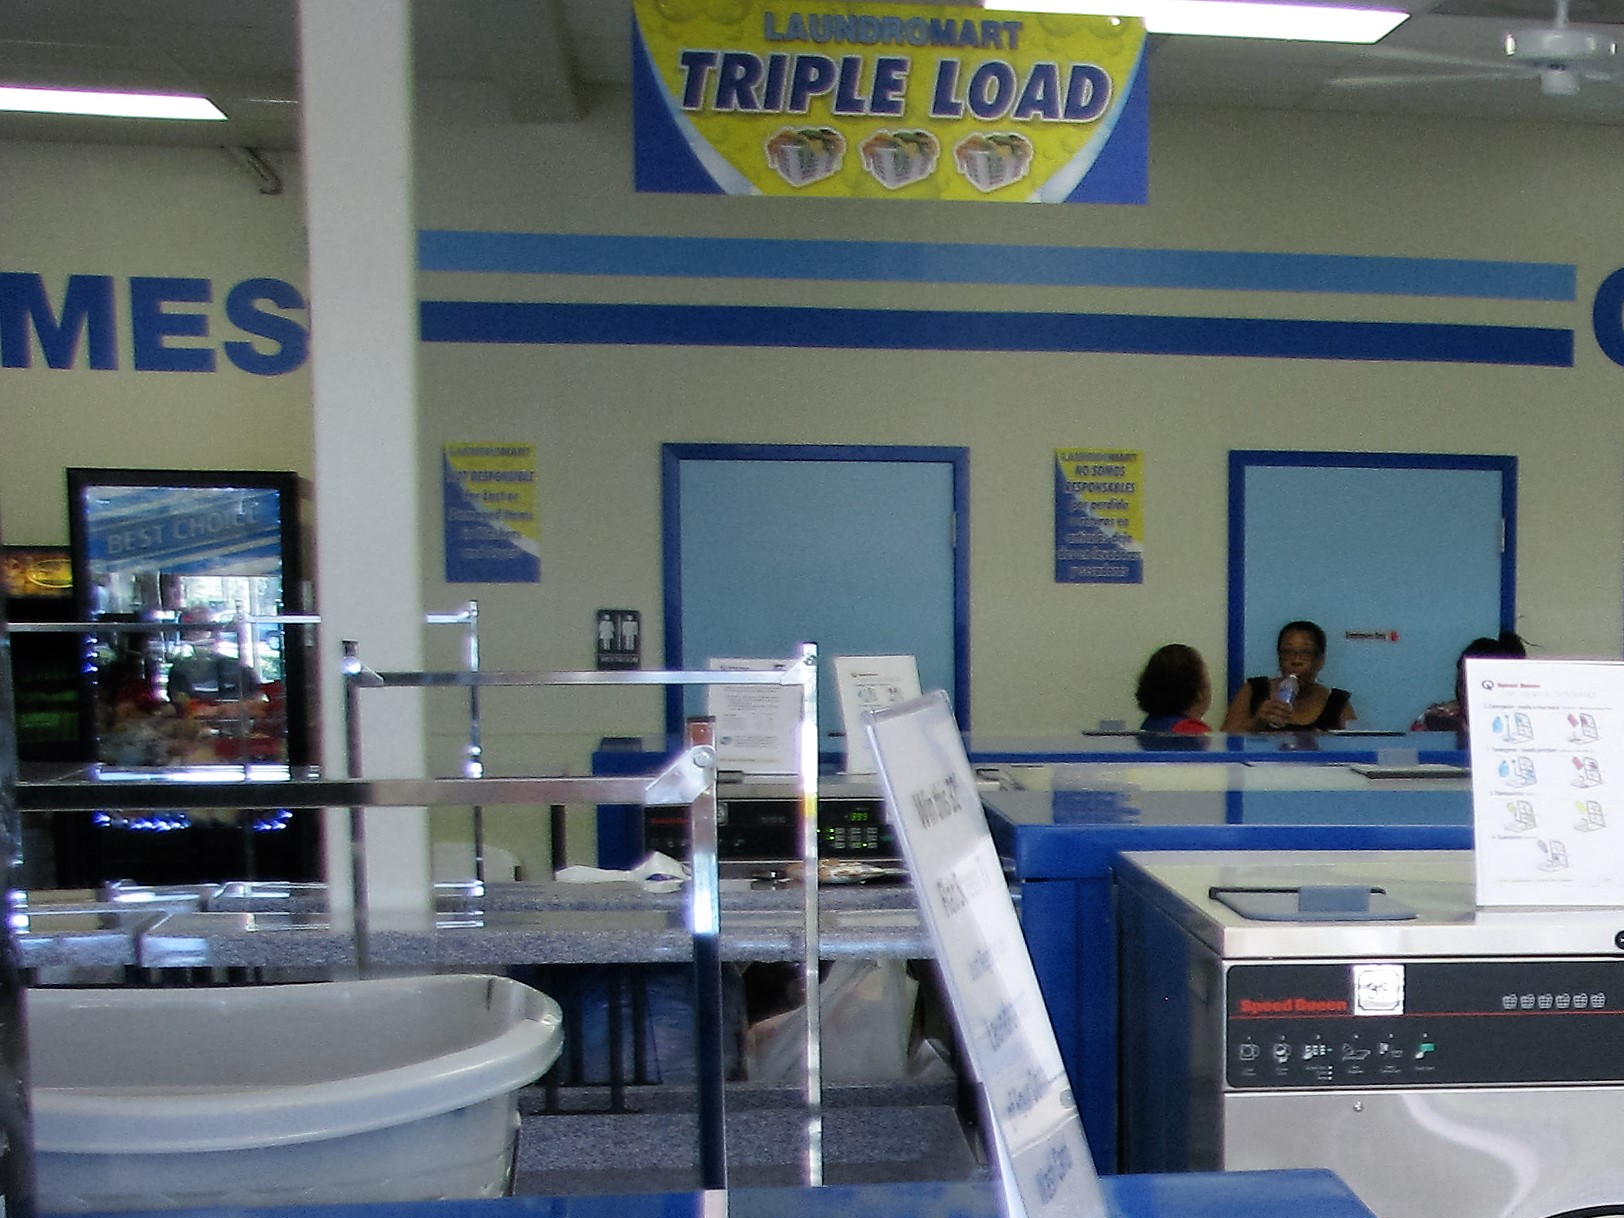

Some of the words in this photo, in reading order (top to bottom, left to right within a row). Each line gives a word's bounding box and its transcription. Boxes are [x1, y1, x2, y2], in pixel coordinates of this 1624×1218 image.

[765, 12, 1023, 50] LAUNDROMART
[679, 50, 911, 118] TRIPLE
[930, 59, 1113, 123] LOAD
[0, 272, 310, 376] MES
[107, 524, 165, 554] BEST
